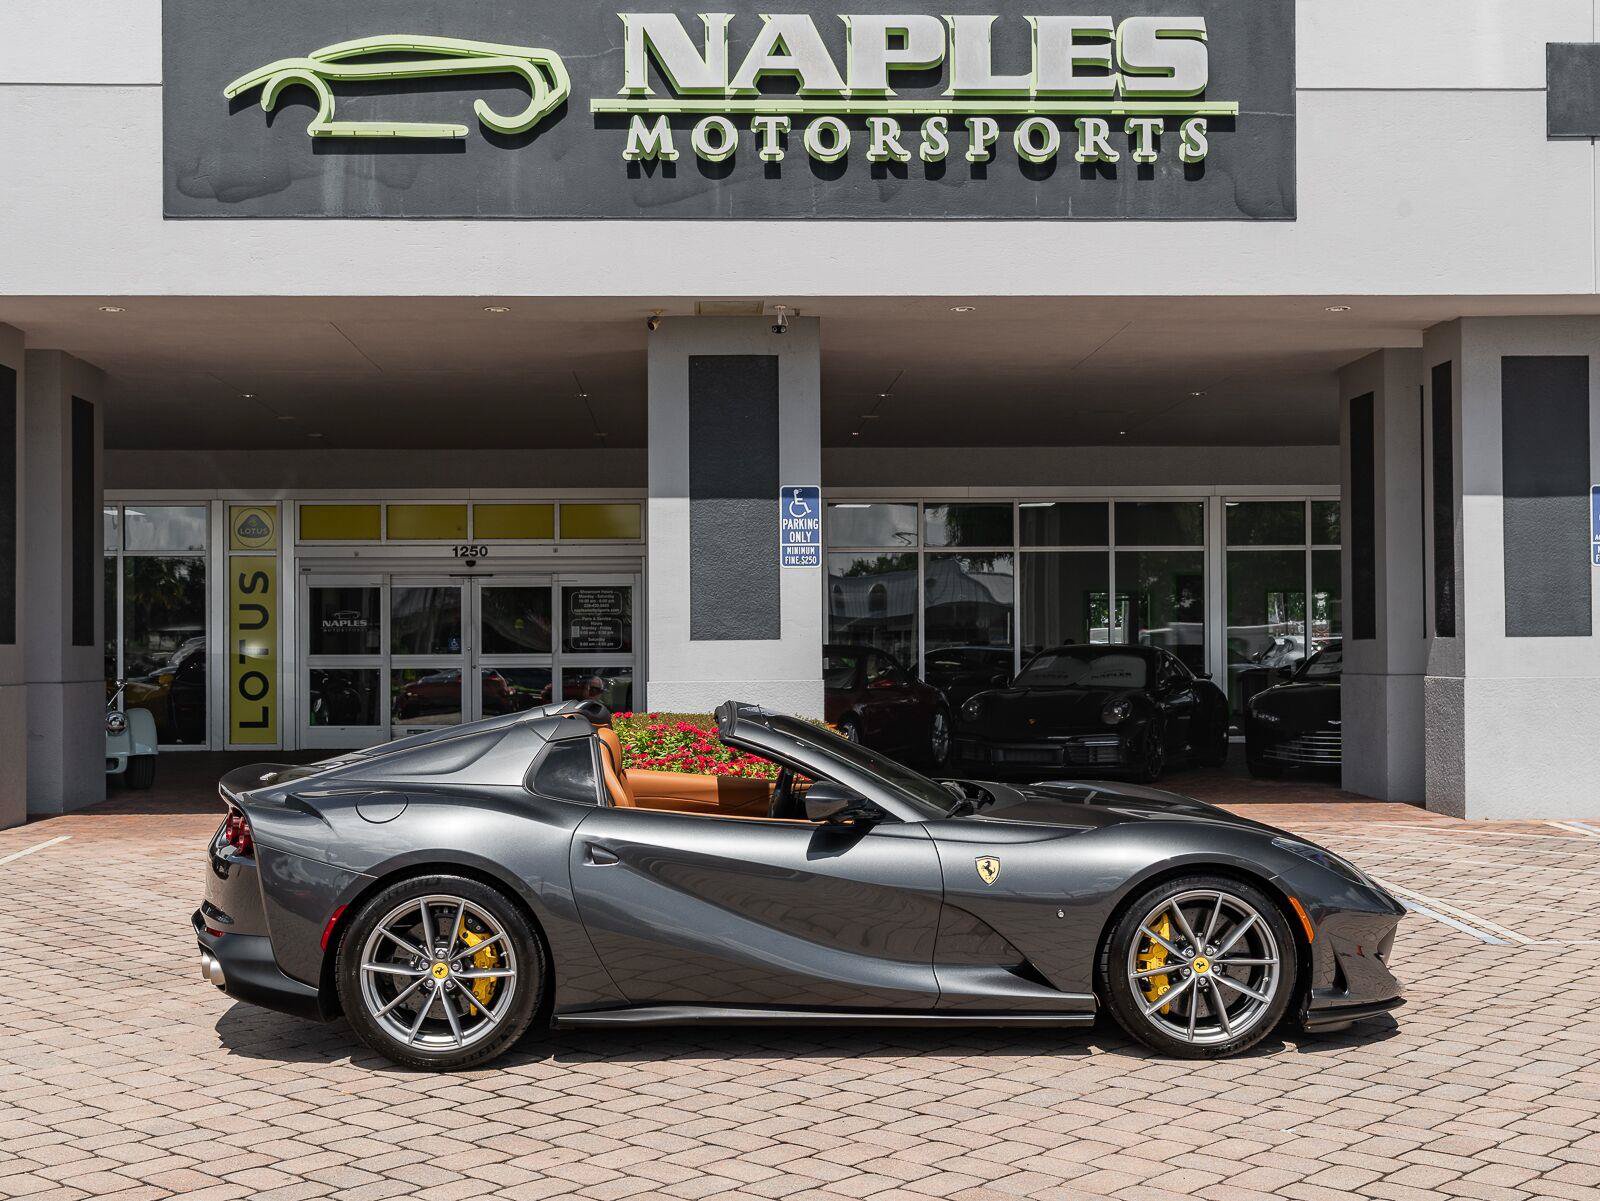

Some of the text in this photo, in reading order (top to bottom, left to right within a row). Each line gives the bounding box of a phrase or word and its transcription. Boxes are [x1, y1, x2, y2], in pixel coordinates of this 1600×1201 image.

[617, 13, 1208, 97] NAPLES
[622, 114, 1209, 163] MOTORSPORTS
[782, 518, 819, 530] PARKING
[240, 527, 269, 535] LOTUS
[789, 531, 812, 543] ONLY
[452, 545, 489, 557] 1250
[786, 546, 815, 555] MINIMUM
[784, 556, 817, 565] FINE $250
[239, 571, 269, 728] LOTUS
